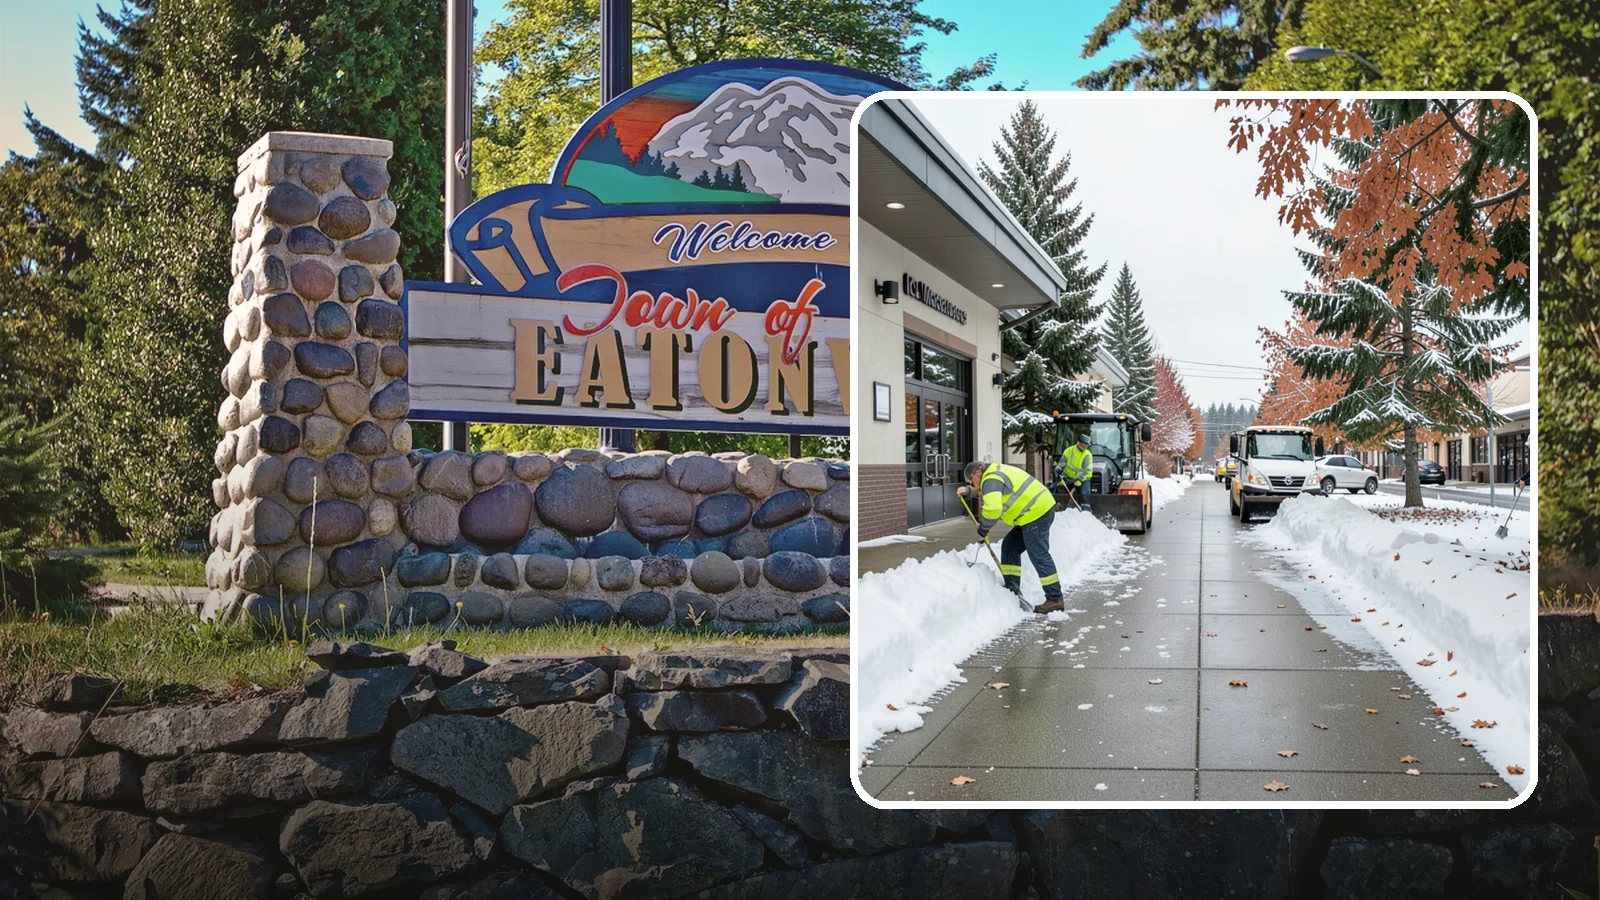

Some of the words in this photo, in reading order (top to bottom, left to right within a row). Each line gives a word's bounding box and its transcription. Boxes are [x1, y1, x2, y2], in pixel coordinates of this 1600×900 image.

[653, 221, 835, 262] Welcome
[557, 264, 736, 335] Town
[764, 278, 825, 364] of
